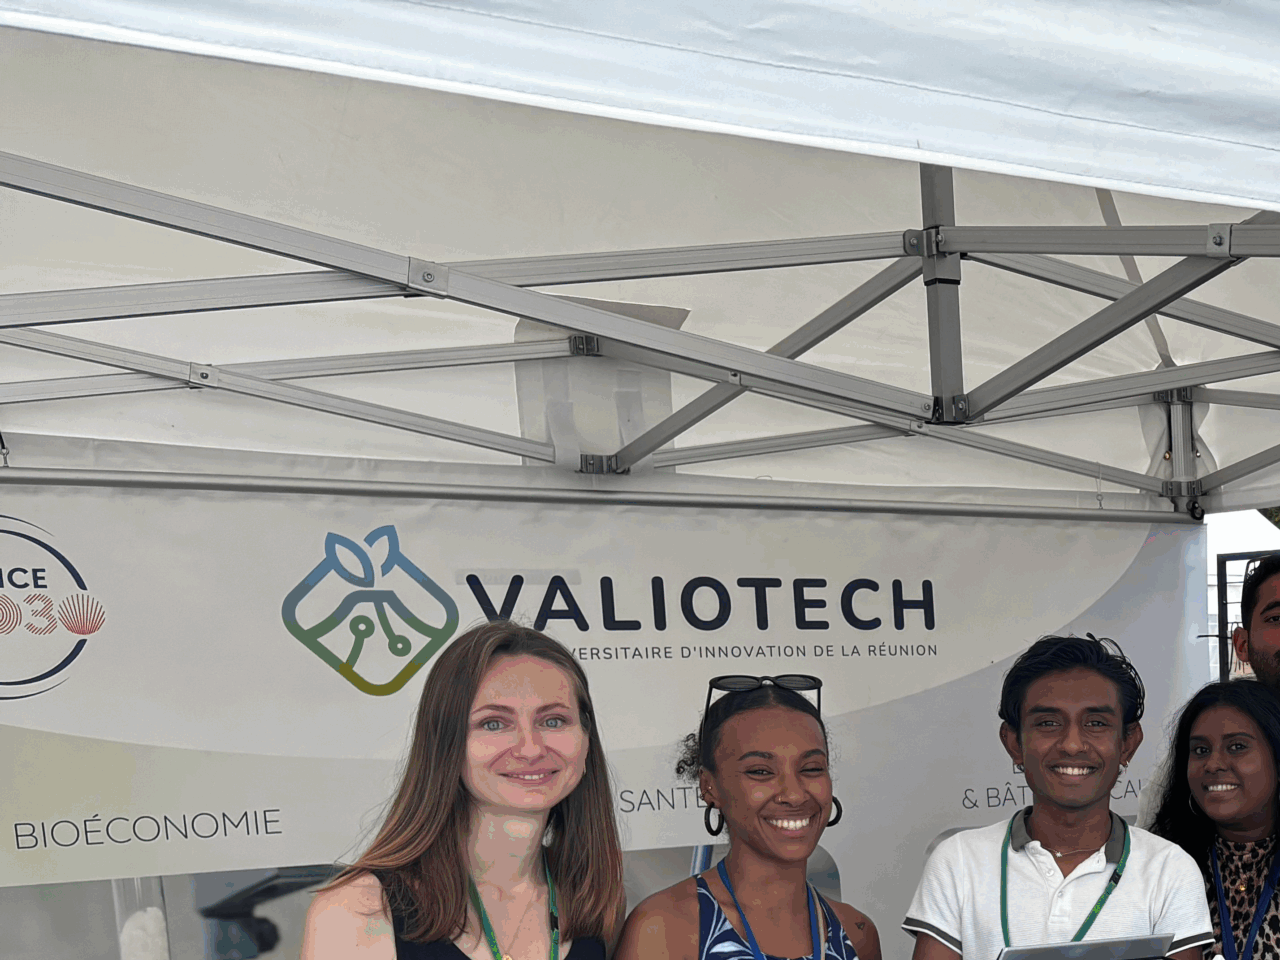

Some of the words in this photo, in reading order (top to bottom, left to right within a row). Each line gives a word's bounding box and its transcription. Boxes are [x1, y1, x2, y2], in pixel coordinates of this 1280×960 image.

[465, 573, 936, 632] VALIOTECH
[681, 645, 806, 659] D'INNOVATION
[813, 644, 835, 658] DE
[841, 644, 861, 657] LA
[868, 641, 938, 658] RÉUNION
[962, 788, 980, 810] &
[14, 808, 283, 850] BIOÉCONOMIE
